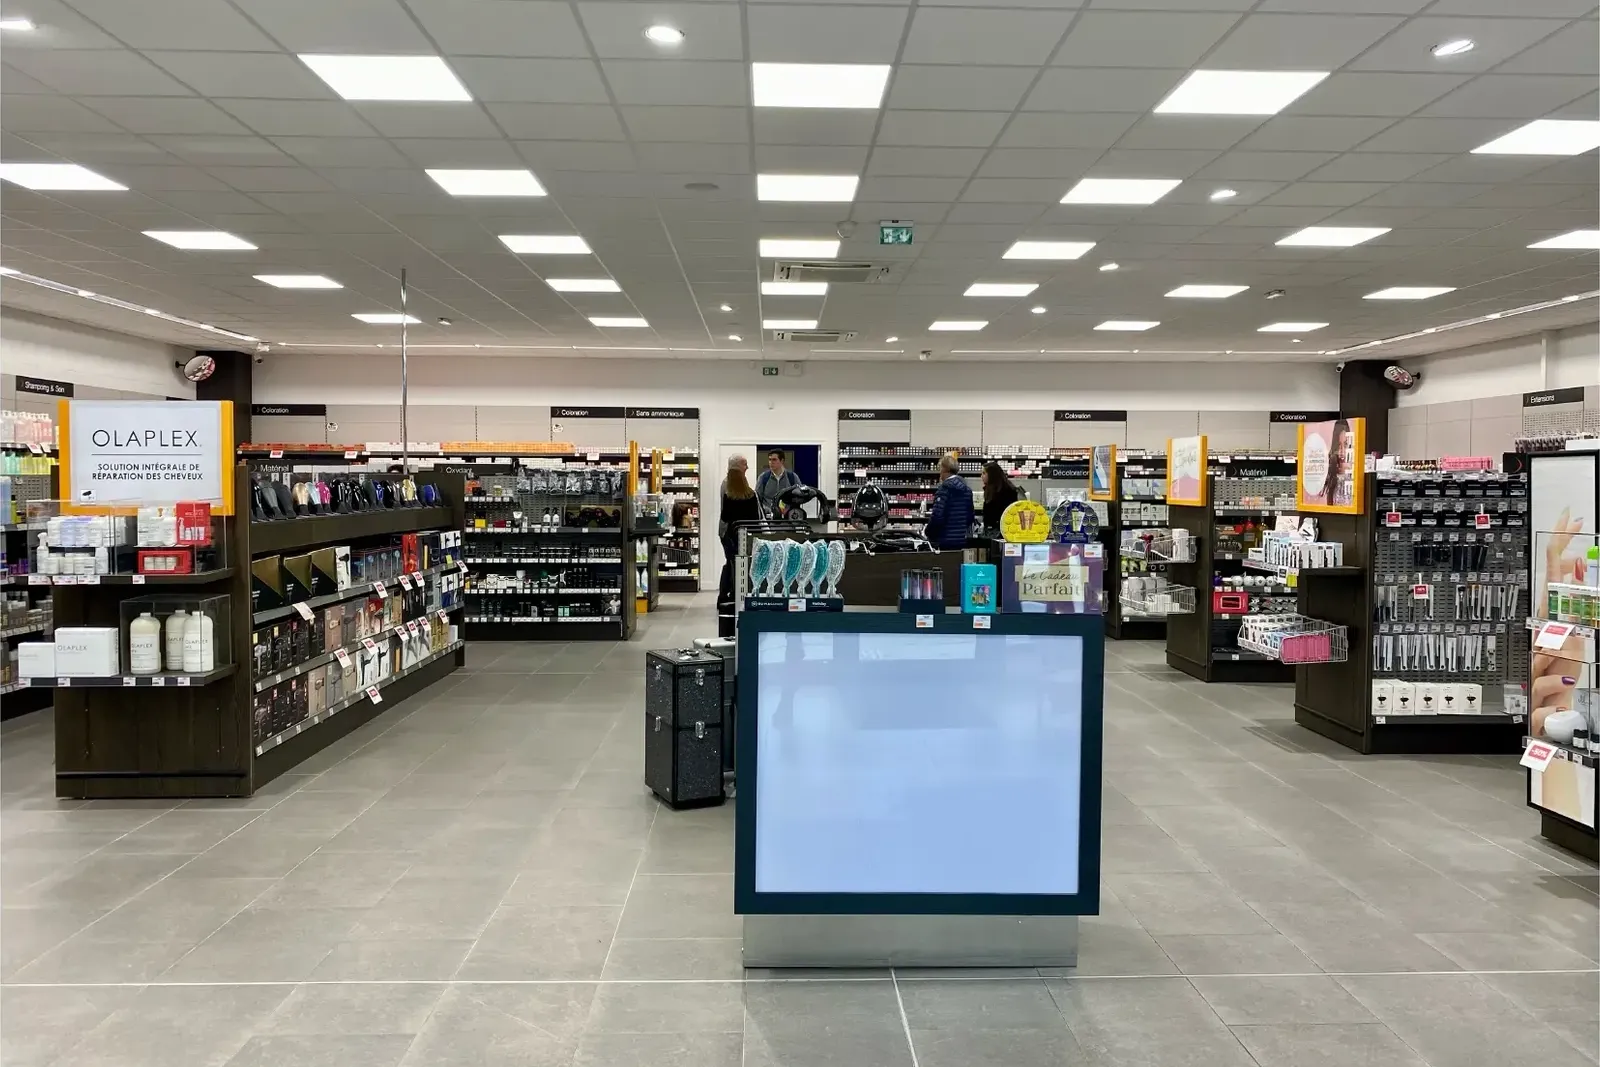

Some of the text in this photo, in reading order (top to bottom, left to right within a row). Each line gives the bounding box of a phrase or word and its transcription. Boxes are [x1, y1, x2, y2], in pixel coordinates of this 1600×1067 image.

[1530, 395, 1555, 404] Extensions
[261, 406, 290, 414] Coloration
[1064, 412, 1092, 420] Coloration
[97, 461, 200, 471] SOLUTION INTÉGRALE DE
[92, 472, 203, 480] RÉPARATION DES CHEVEUX
[1239, 468, 1268, 477] Matériel
[1023, 569, 1080, 580] Le Cadeau
[1023, 582, 1081, 597] Parfait
